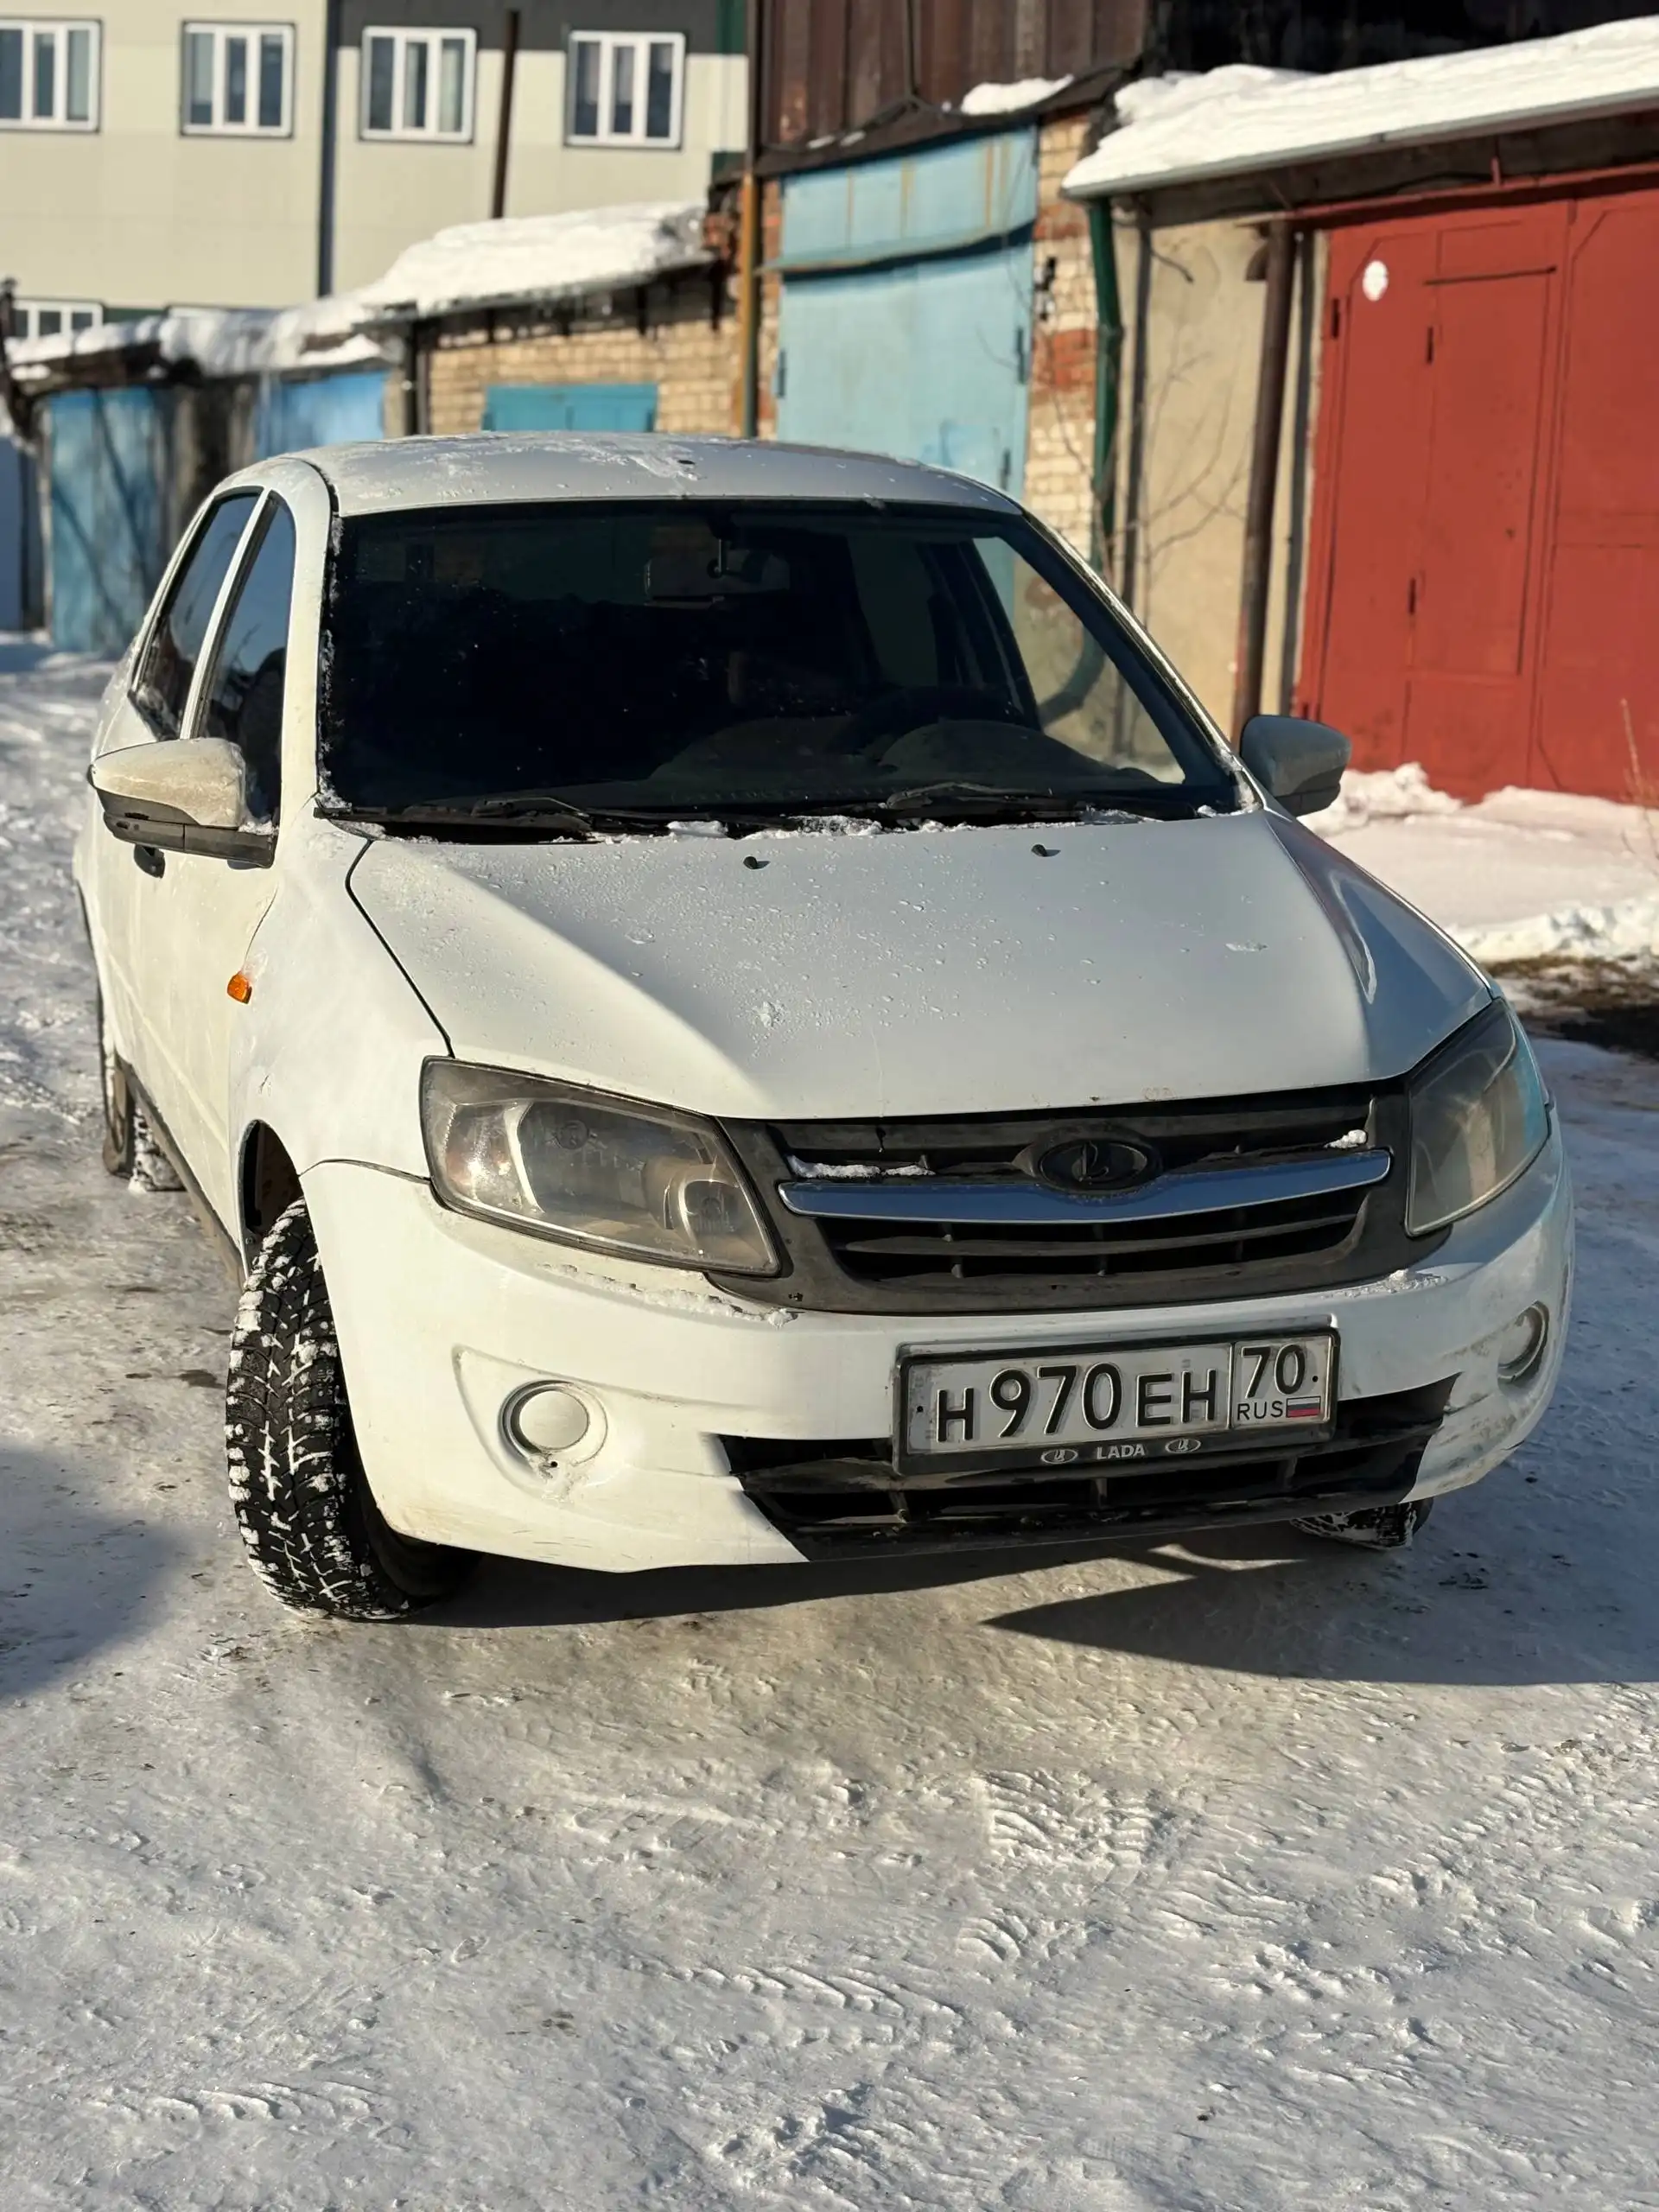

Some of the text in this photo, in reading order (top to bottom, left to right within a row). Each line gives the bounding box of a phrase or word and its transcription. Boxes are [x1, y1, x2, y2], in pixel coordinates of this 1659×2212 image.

[1242, 1344, 1306, 1399] 70
[1236, 1400, 1283, 1421] RUS
[1096, 1444, 1146, 1459] LADA
